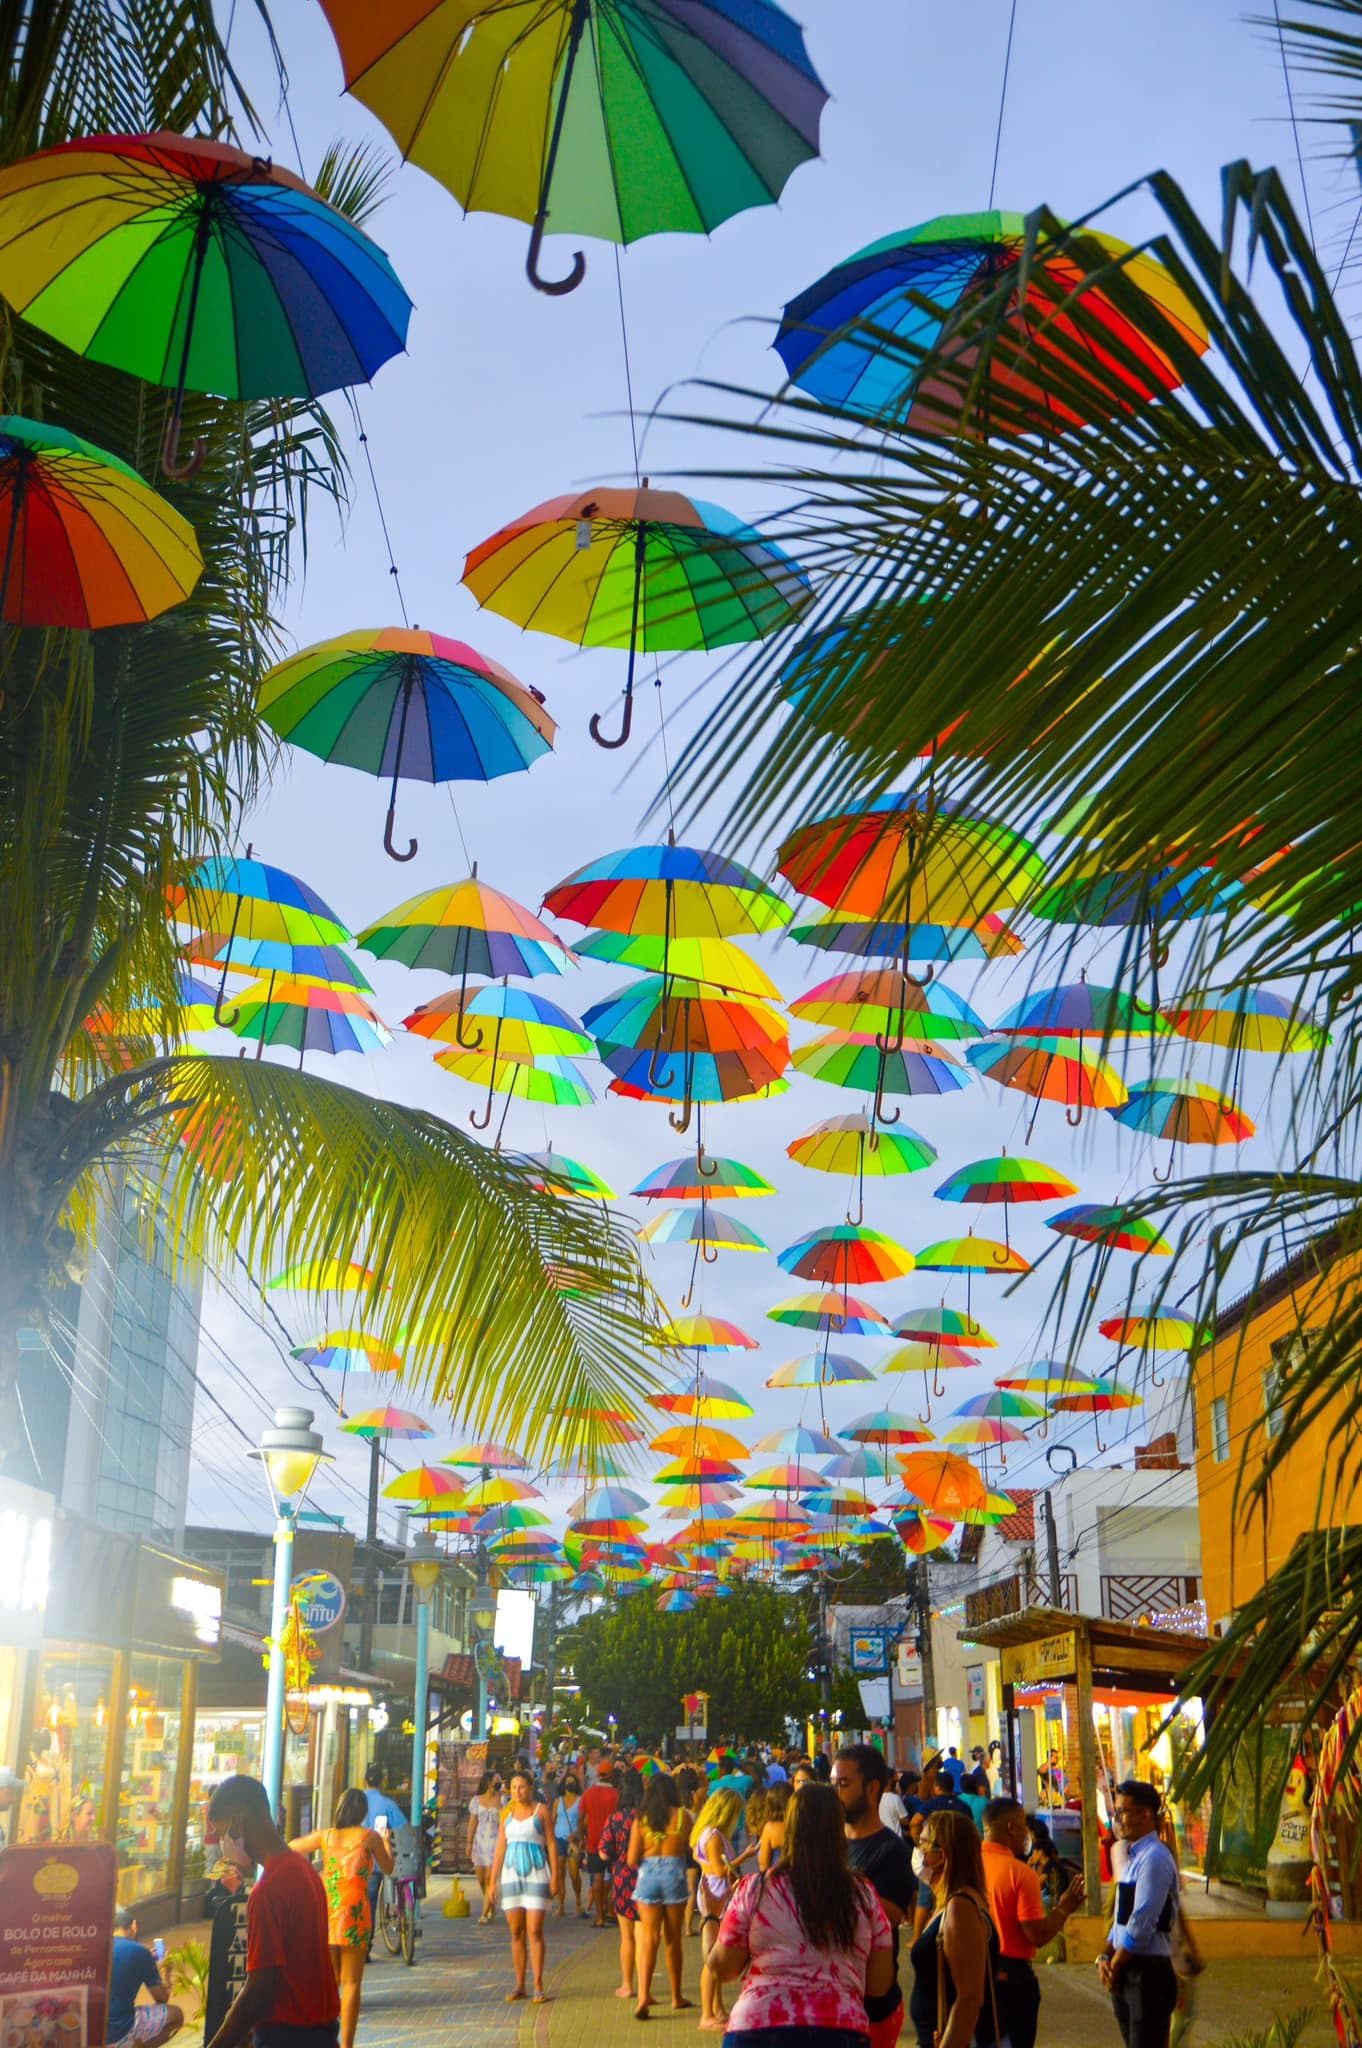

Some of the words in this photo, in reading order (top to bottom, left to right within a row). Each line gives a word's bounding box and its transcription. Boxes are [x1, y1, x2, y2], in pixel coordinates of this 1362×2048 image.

[32, 1912, 41, 1923] O
[4, 1927, 41, 1941] BOLO
[42, 1926, 61, 1939] DE
[62, 1925, 97, 1938] ROLO
[11, 1945, 23, 1955] de
[30, 1970, 47, 1982] DA
